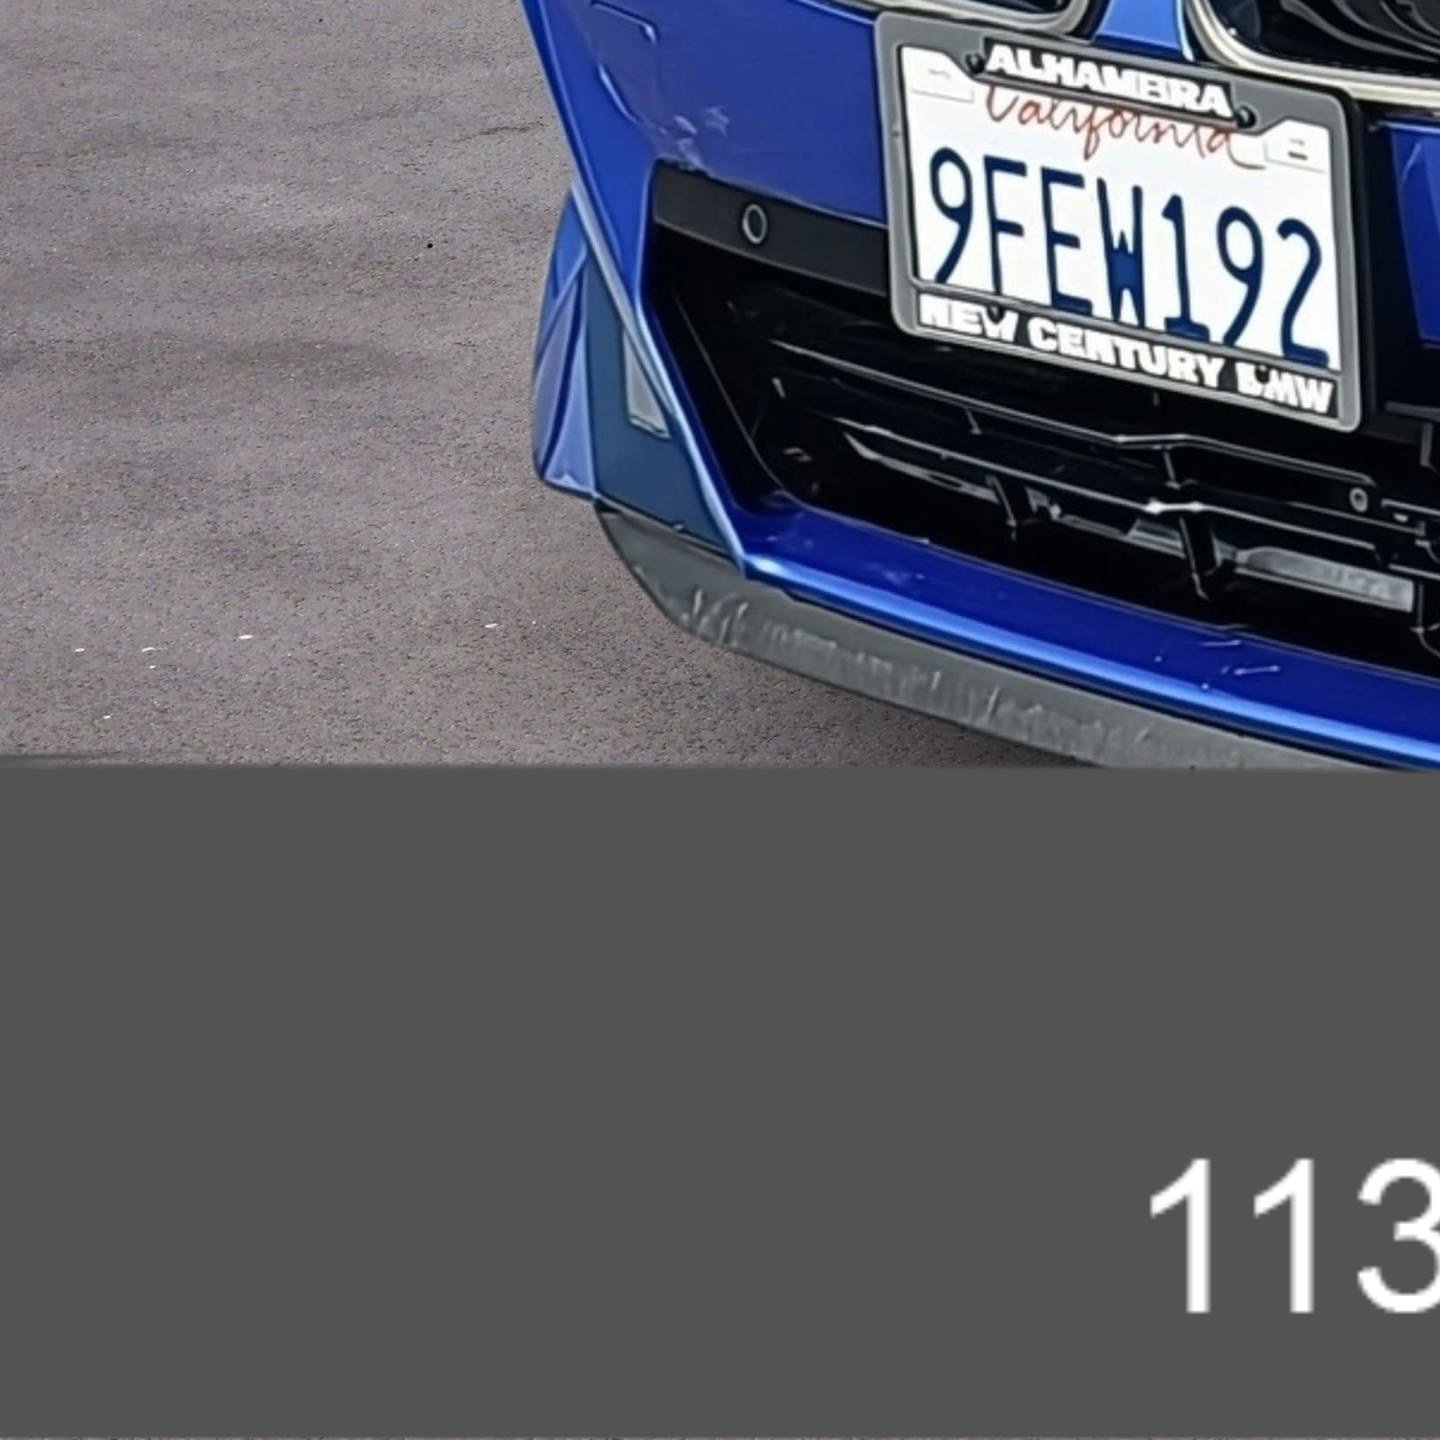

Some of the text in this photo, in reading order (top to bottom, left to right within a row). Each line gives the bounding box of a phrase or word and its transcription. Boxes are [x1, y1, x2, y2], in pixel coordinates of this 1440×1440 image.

[984, 43, 1236, 119] ALHAMBRA
[985, 82, 1267, 171] California
[928, 146, 1331, 371] 9FEW192
[917, 293, 1020, 343] NEW
[1026, 318, 1226, 390] CENTURY
